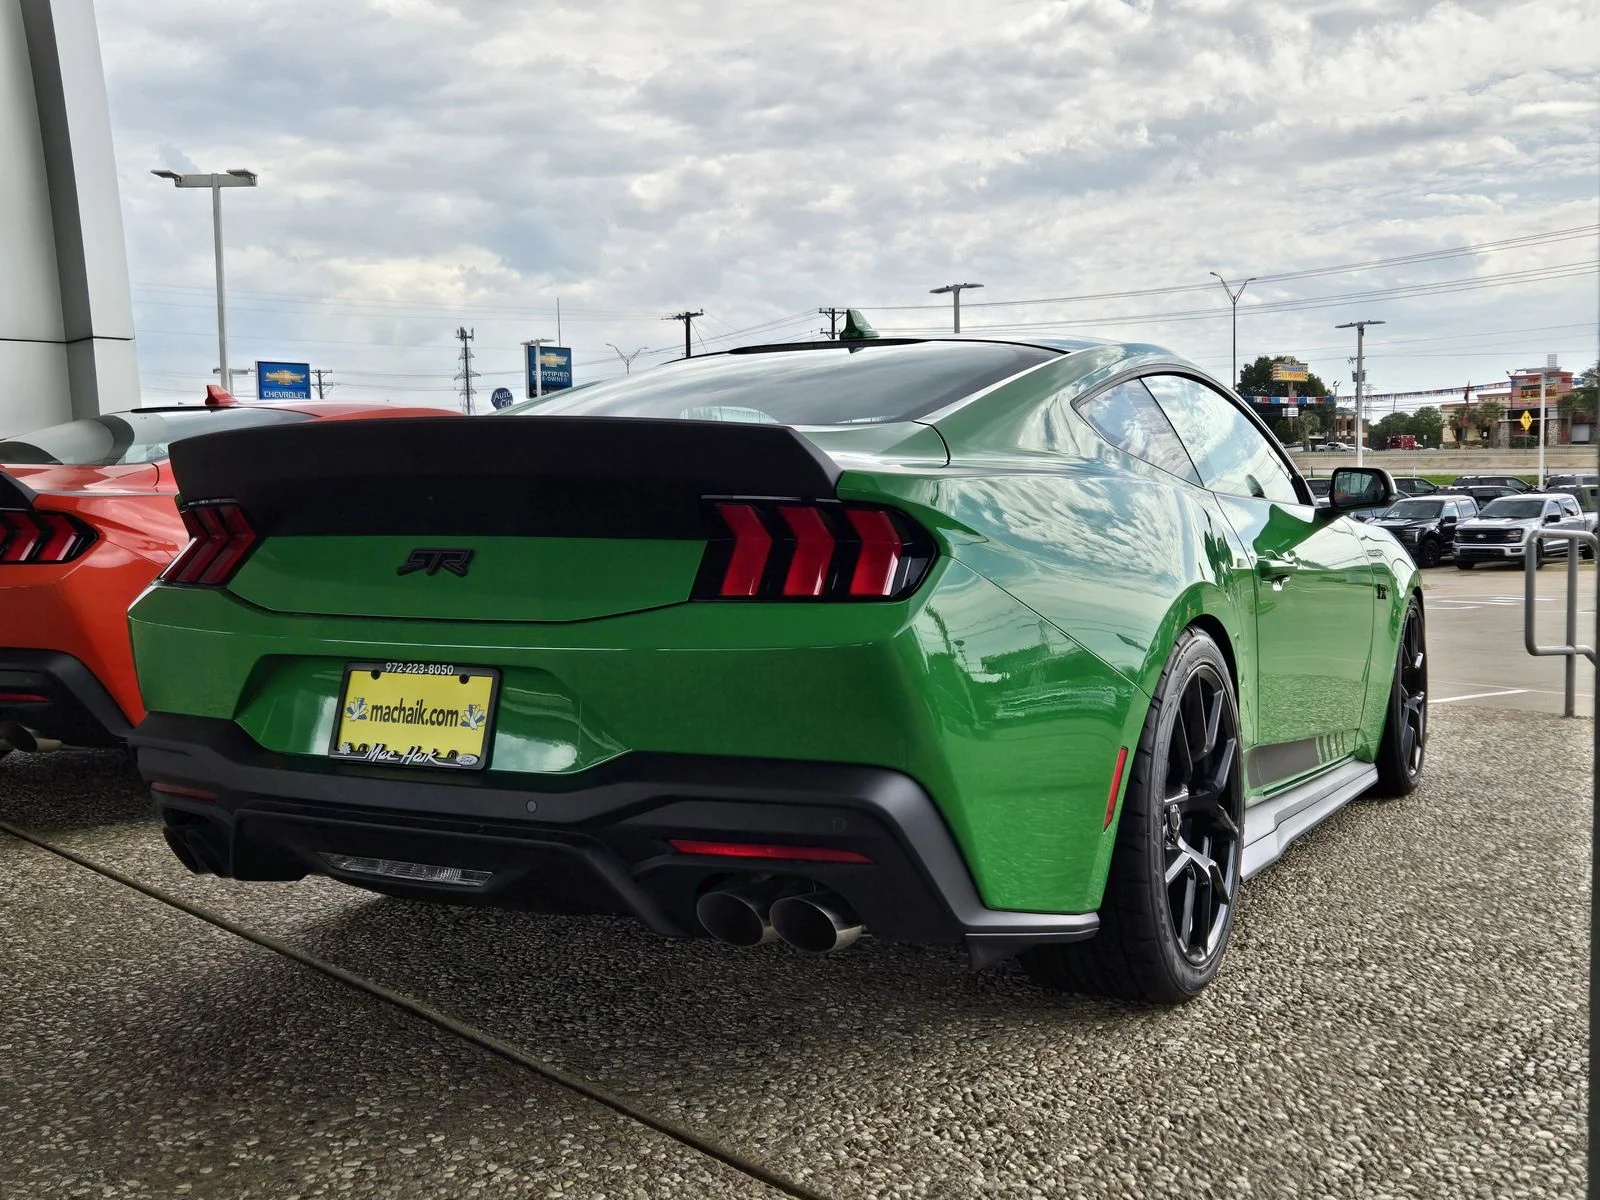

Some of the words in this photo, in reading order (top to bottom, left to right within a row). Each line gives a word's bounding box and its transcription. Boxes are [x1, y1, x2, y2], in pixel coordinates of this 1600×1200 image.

[264, 391, 306, 399] CHEVROLET
[493, 390, 512, 403] Auto
[385, 662, 455, 676] 972-223-8050
[369, 697, 459, 728] machaik.com
[366, 743, 397, 763] Mac
[400, 745, 438, 765] Haik
